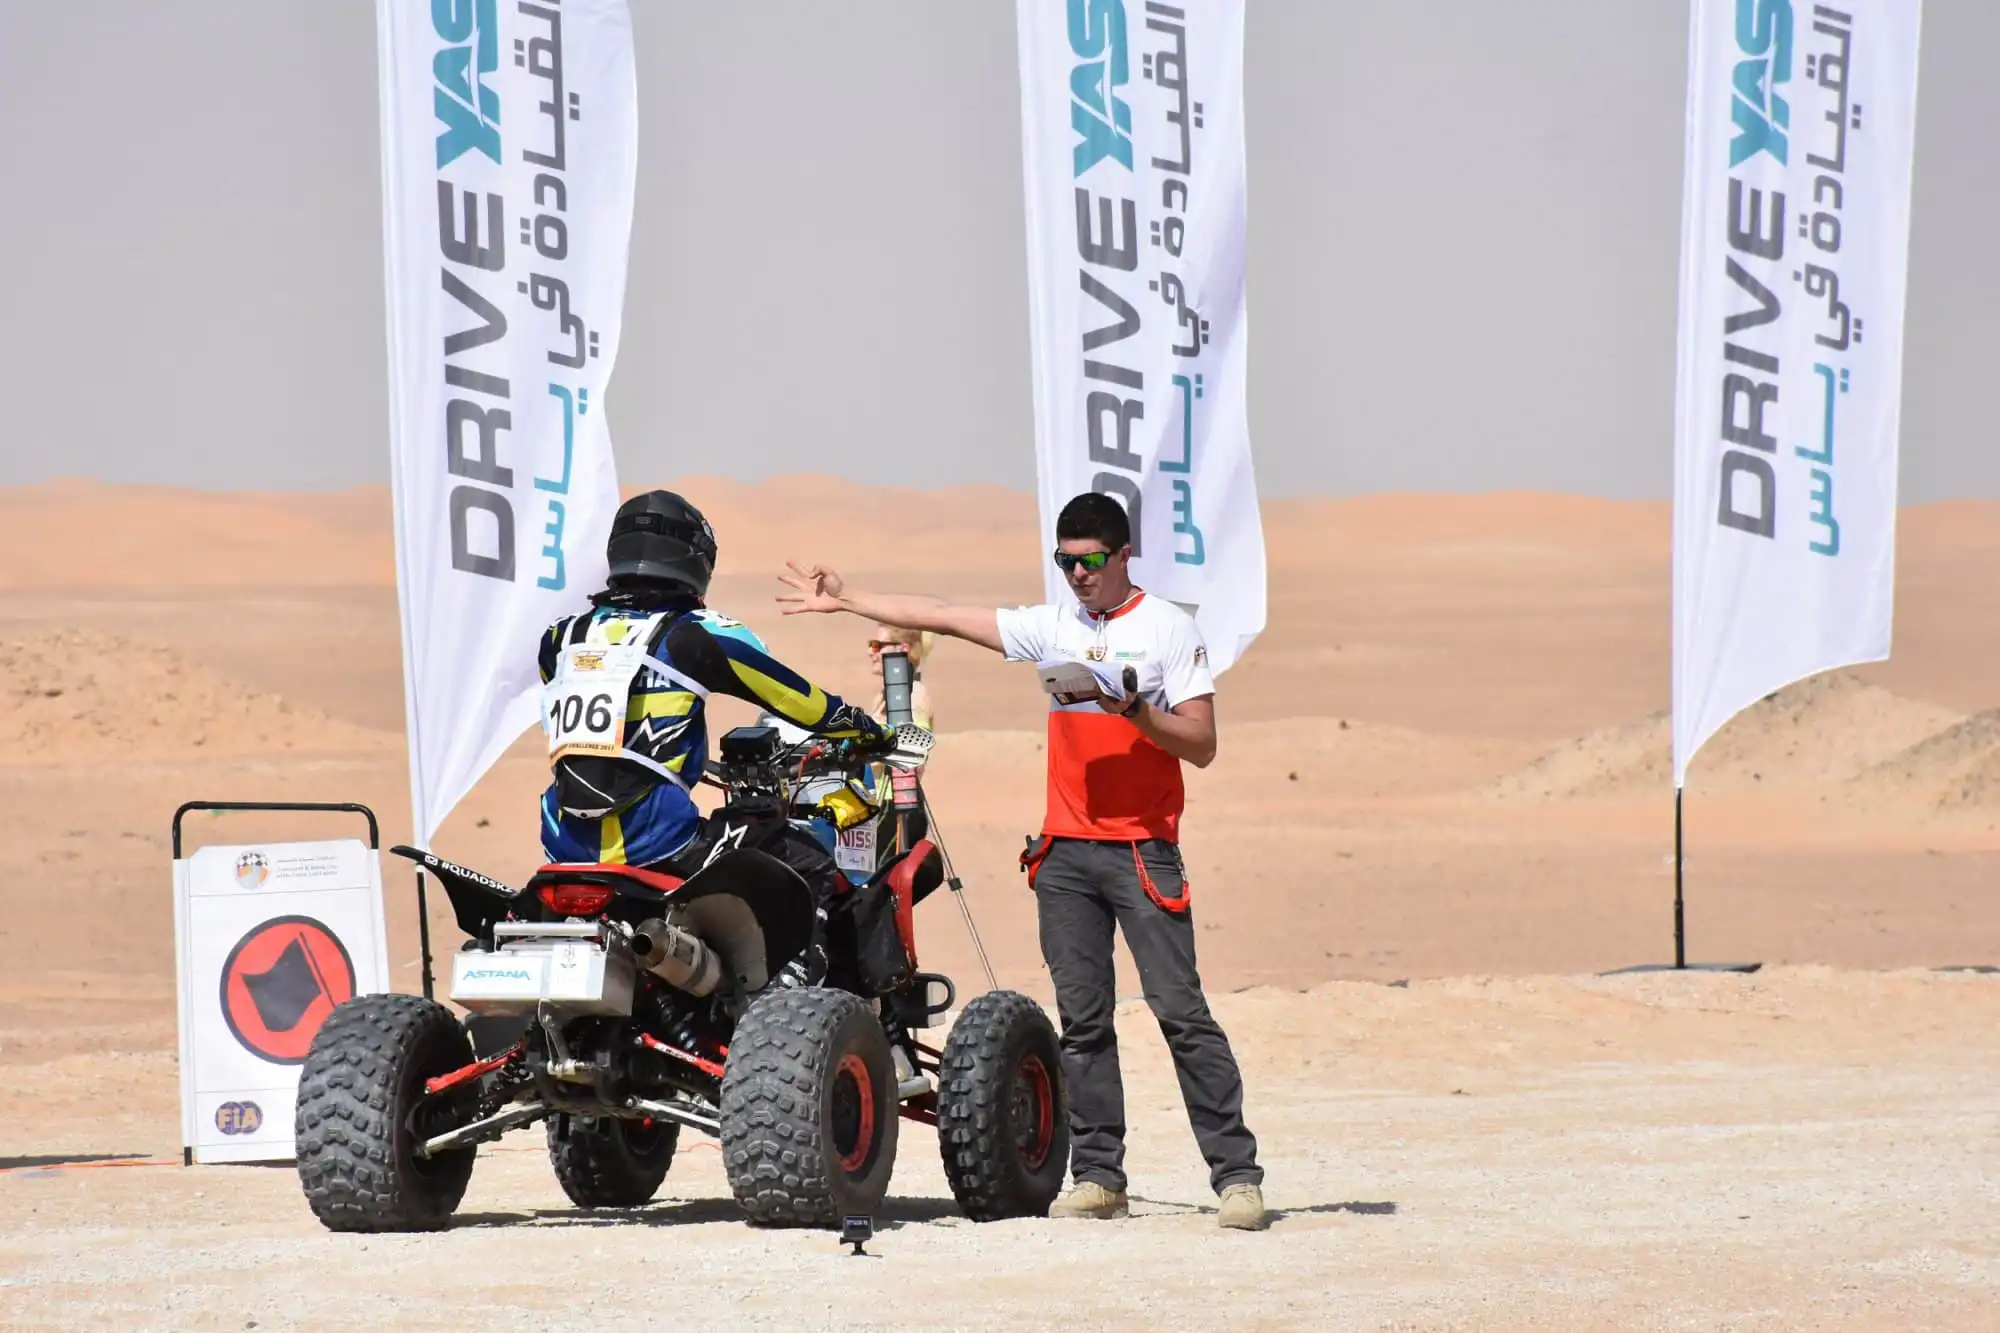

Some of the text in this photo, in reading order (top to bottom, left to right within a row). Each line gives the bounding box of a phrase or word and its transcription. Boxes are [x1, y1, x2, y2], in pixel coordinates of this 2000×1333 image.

[1067, 0, 1134, 178] YAS
[518, 273, 599, 368] في
[1149, 272, 1210, 358] في
[1718, 0, 1793, 540] DRIVE YAS
[1793, 5, 1863, 557] القيادة في ياس
[437, 180, 516, 582] DRIVE
[1158, 374, 1206, 566] ياس
[535, 384, 587, 591] ياس
[550, 693, 613, 740] 106
[462, 969, 531, 981] ASTANA
